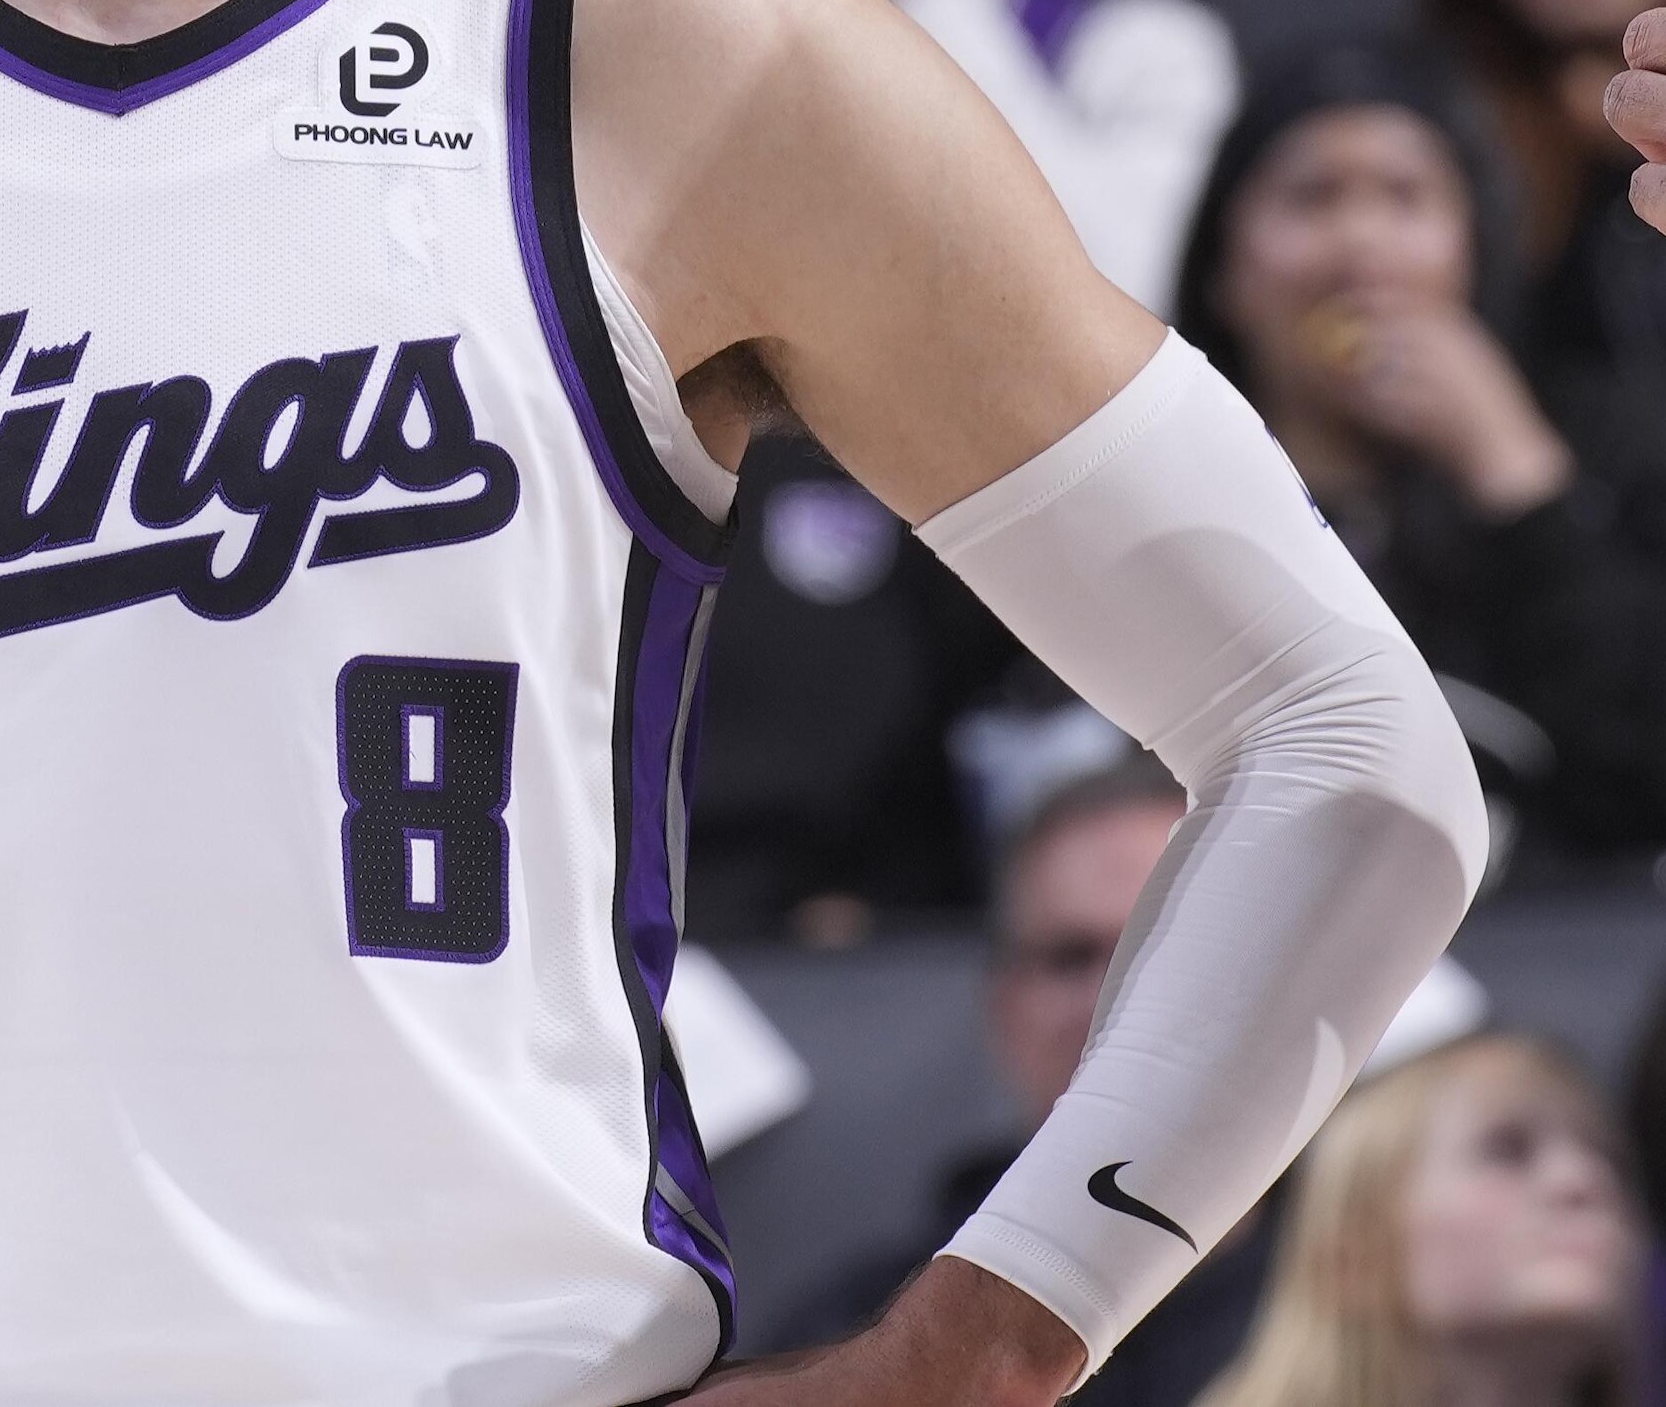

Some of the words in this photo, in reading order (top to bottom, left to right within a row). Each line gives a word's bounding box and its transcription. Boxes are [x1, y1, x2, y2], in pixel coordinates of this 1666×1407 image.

[294, 124, 408, 145] PHOONG
[415, 129, 473, 149] LAW
[334, 654, 520, 963] 8
